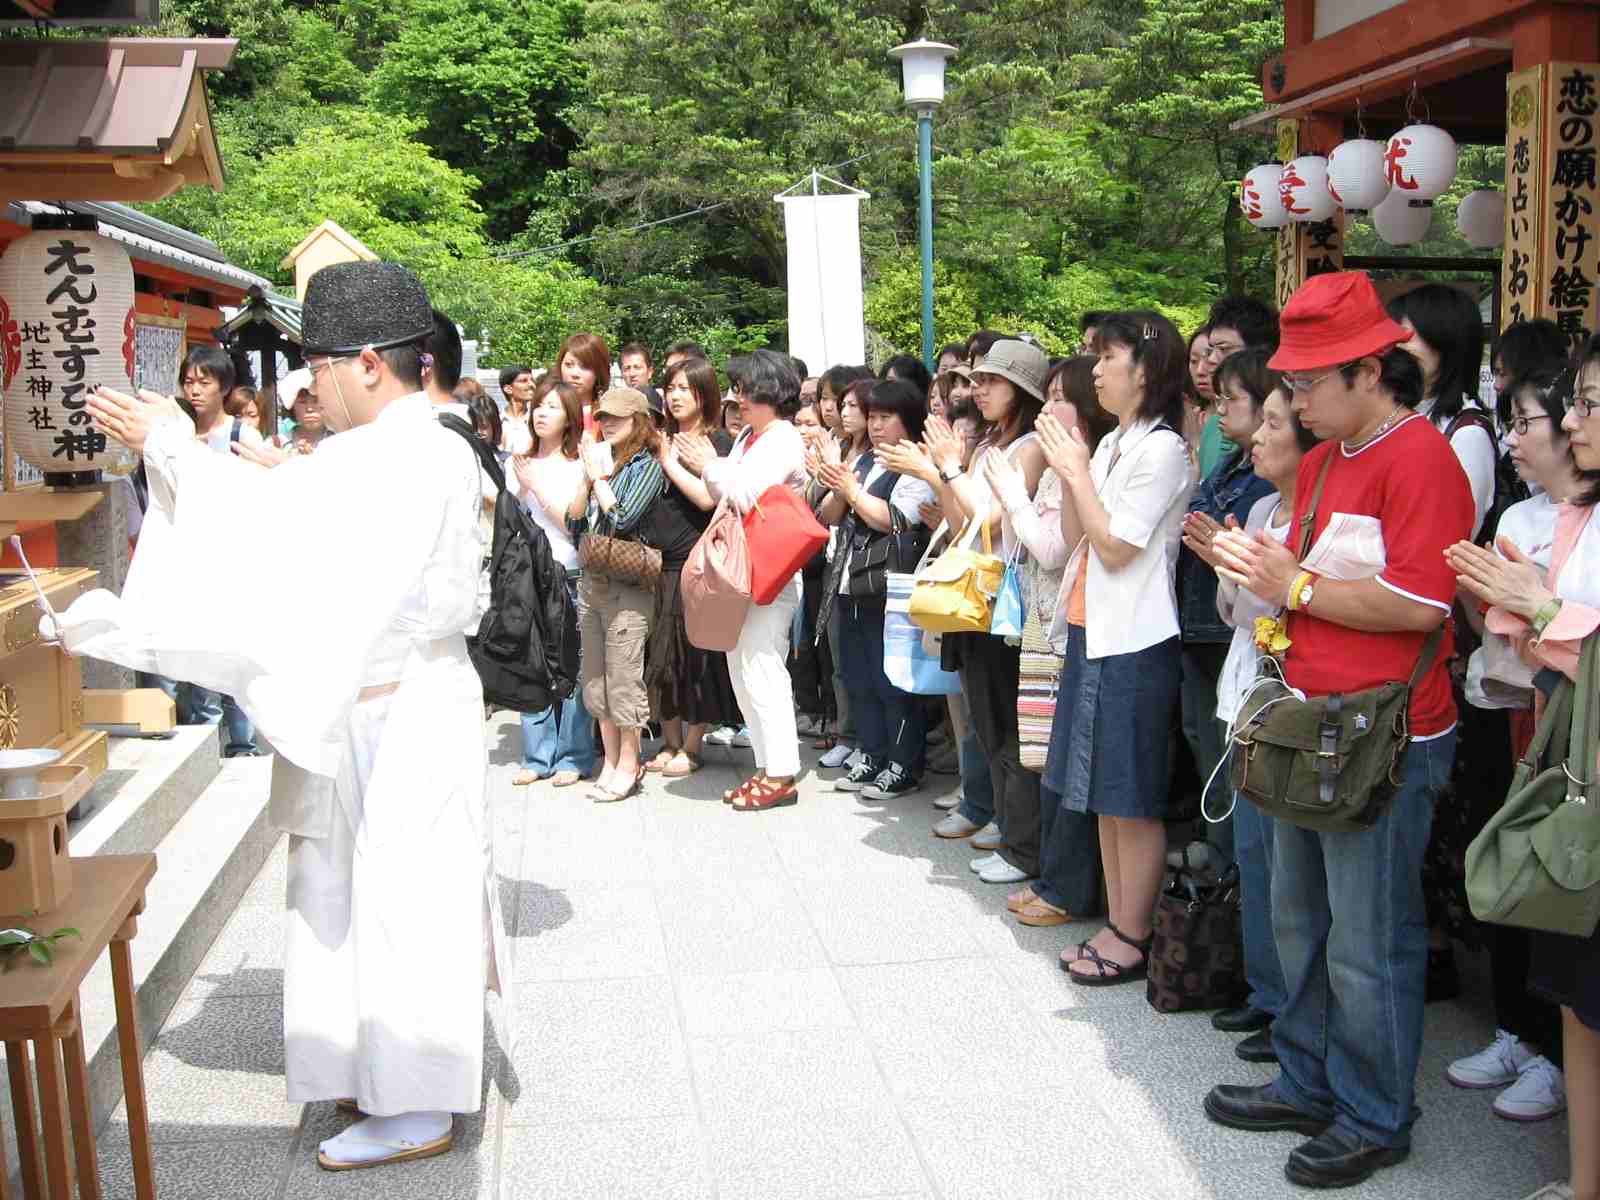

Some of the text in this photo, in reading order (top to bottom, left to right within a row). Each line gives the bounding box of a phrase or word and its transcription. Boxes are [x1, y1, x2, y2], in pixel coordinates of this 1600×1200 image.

[20, 320, 57, 431] 地主神社
[44, 239, 107, 462] えんむすびの神
